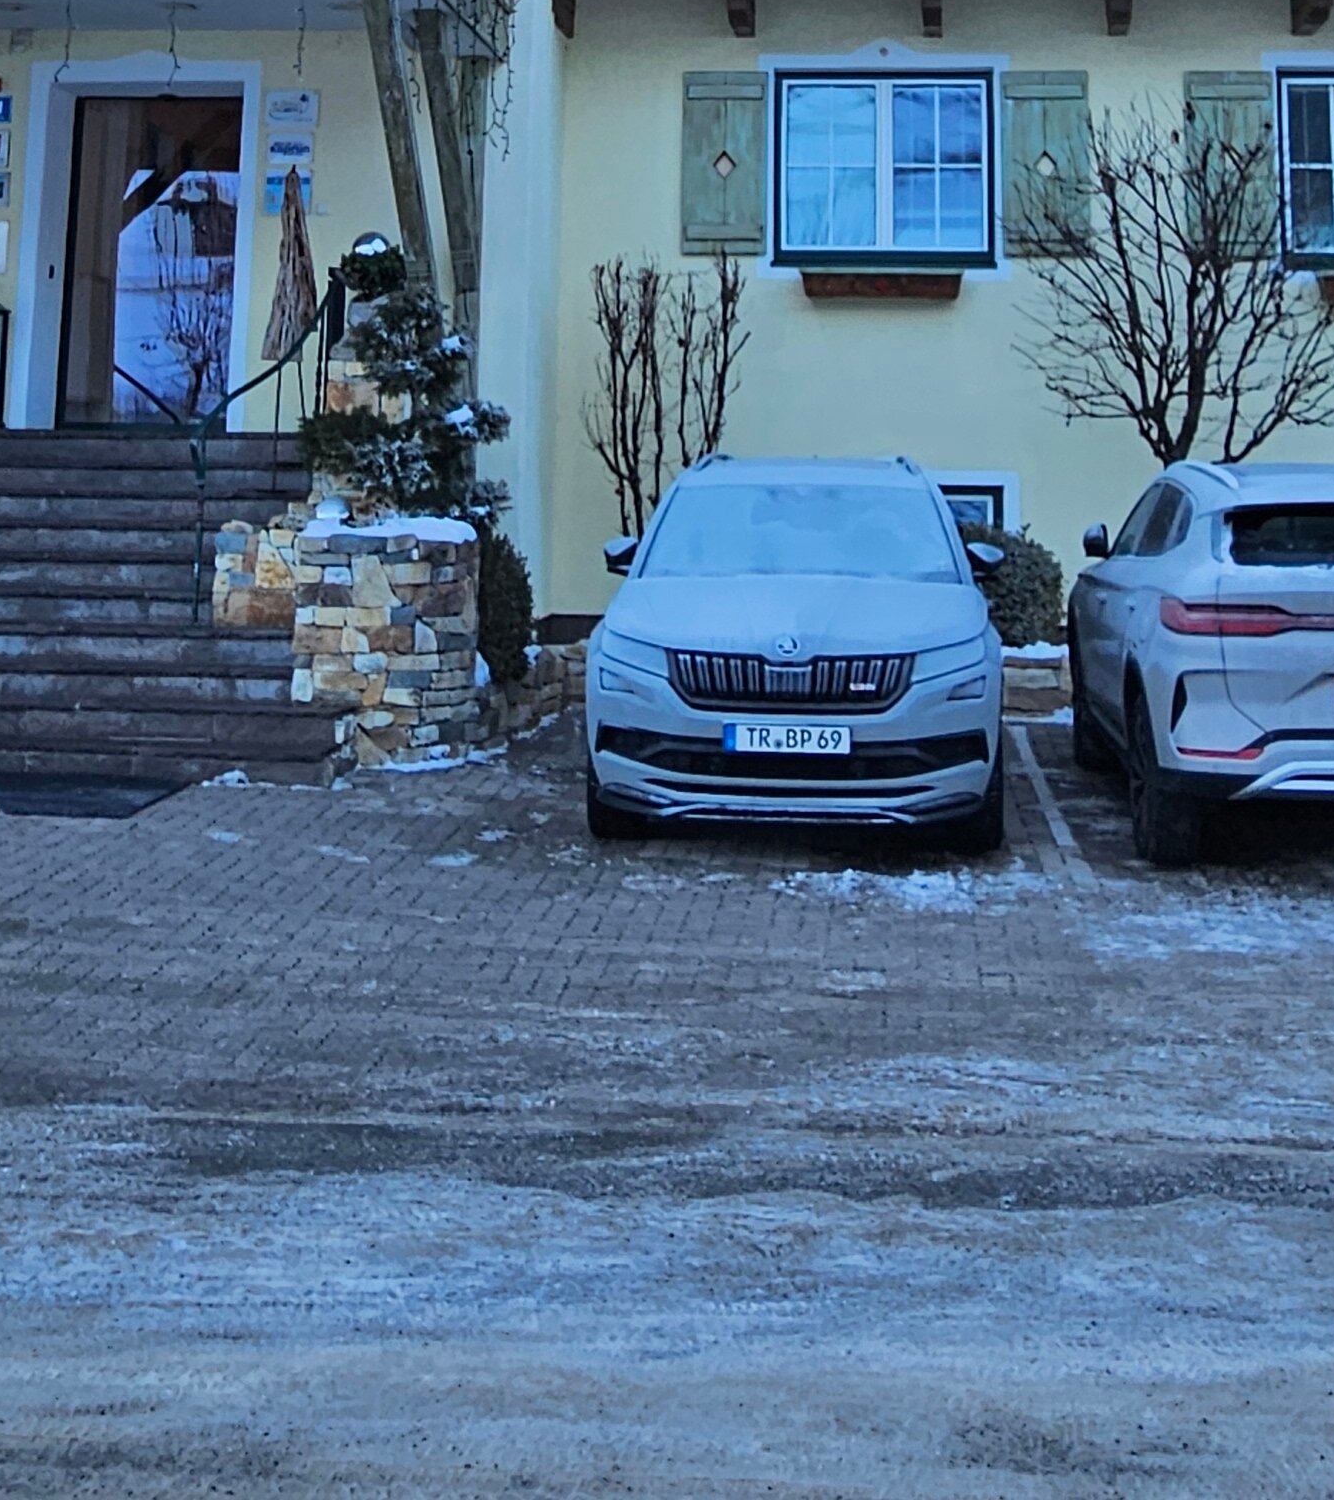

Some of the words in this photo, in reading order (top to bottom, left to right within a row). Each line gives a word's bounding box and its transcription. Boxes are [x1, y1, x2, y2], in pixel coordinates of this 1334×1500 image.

[746, 727, 771, 748] TR
[786, 728, 812, 749] BP
[817, 729, 842, 750] 69
